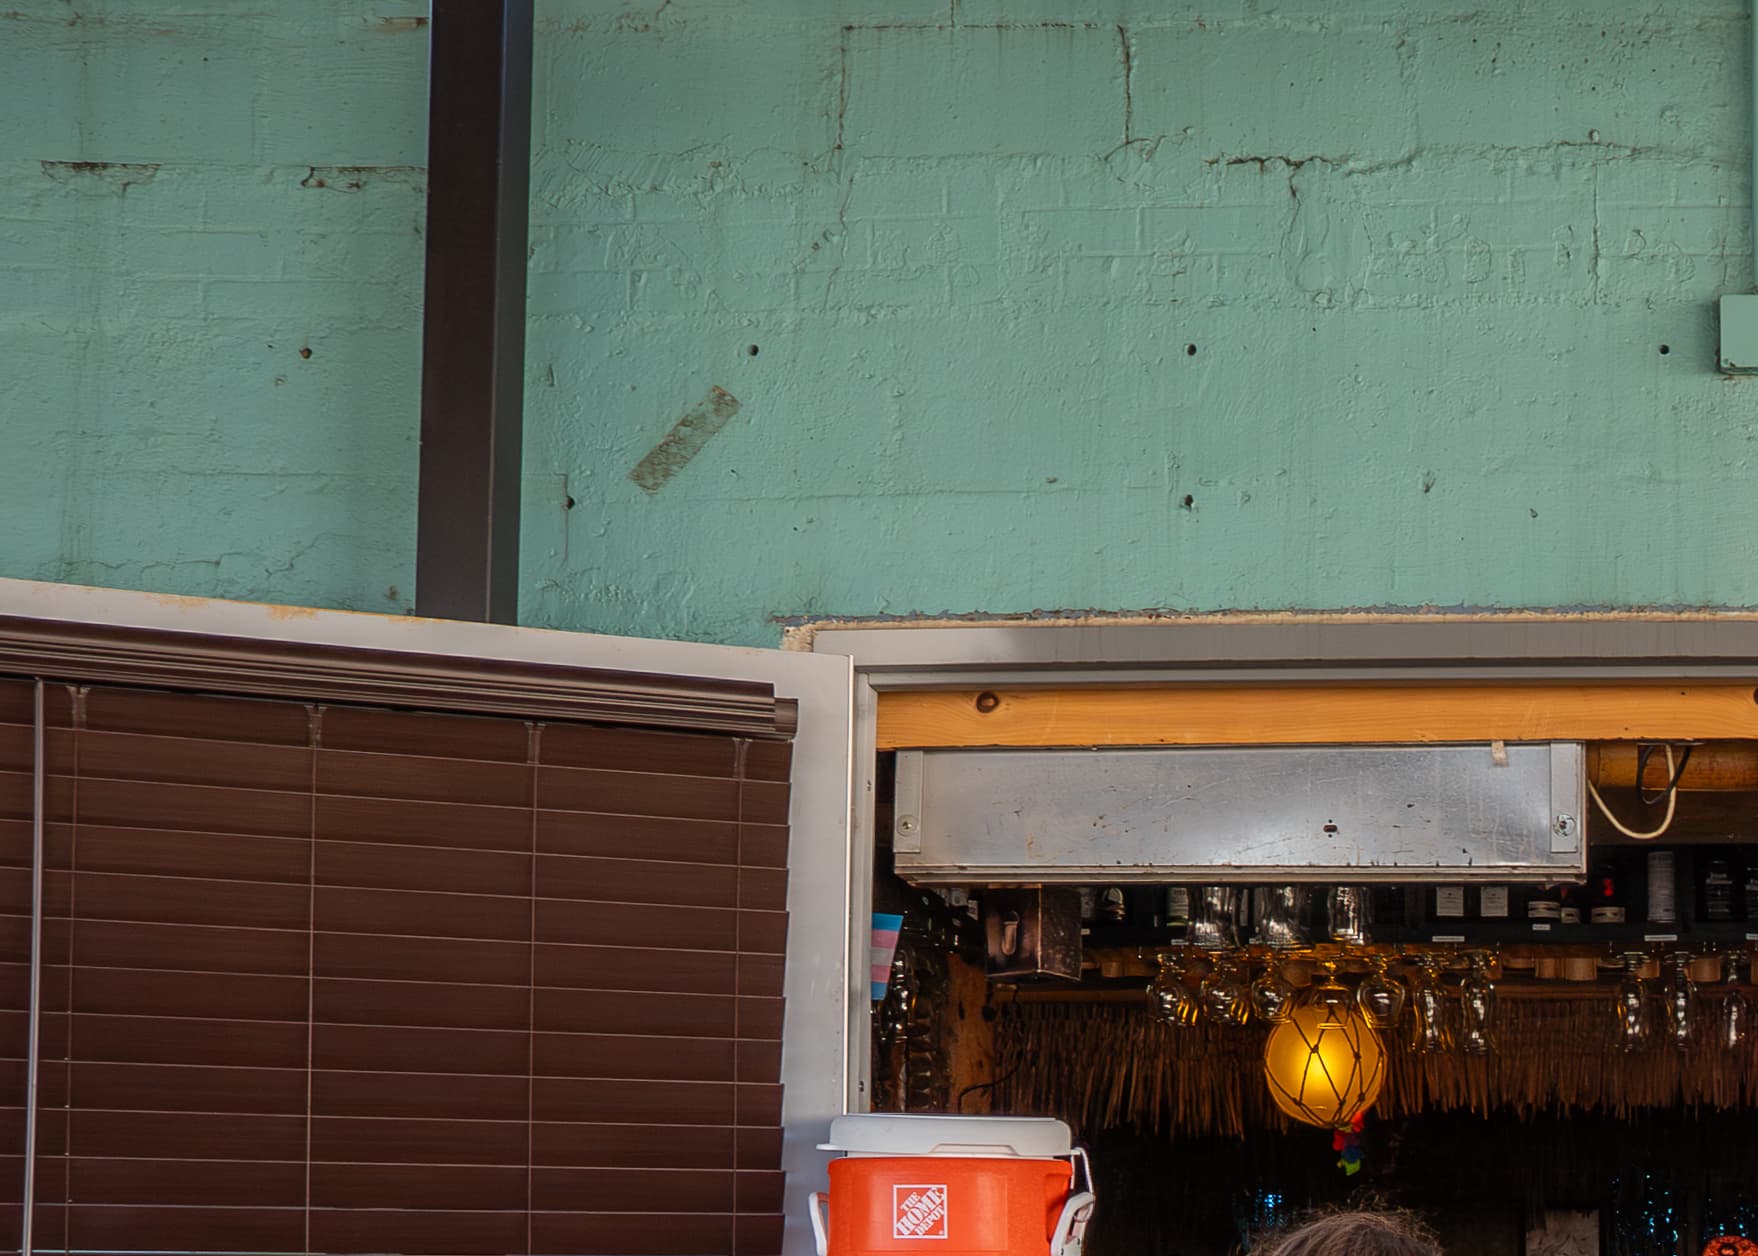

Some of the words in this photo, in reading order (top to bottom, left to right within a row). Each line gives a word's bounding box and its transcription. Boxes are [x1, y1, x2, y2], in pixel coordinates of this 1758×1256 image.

[895, 1186, 945, 1235] HOME
[899, 1191, 921, 1212] THE
[914, 1205, 945, 1236] DEPOT
